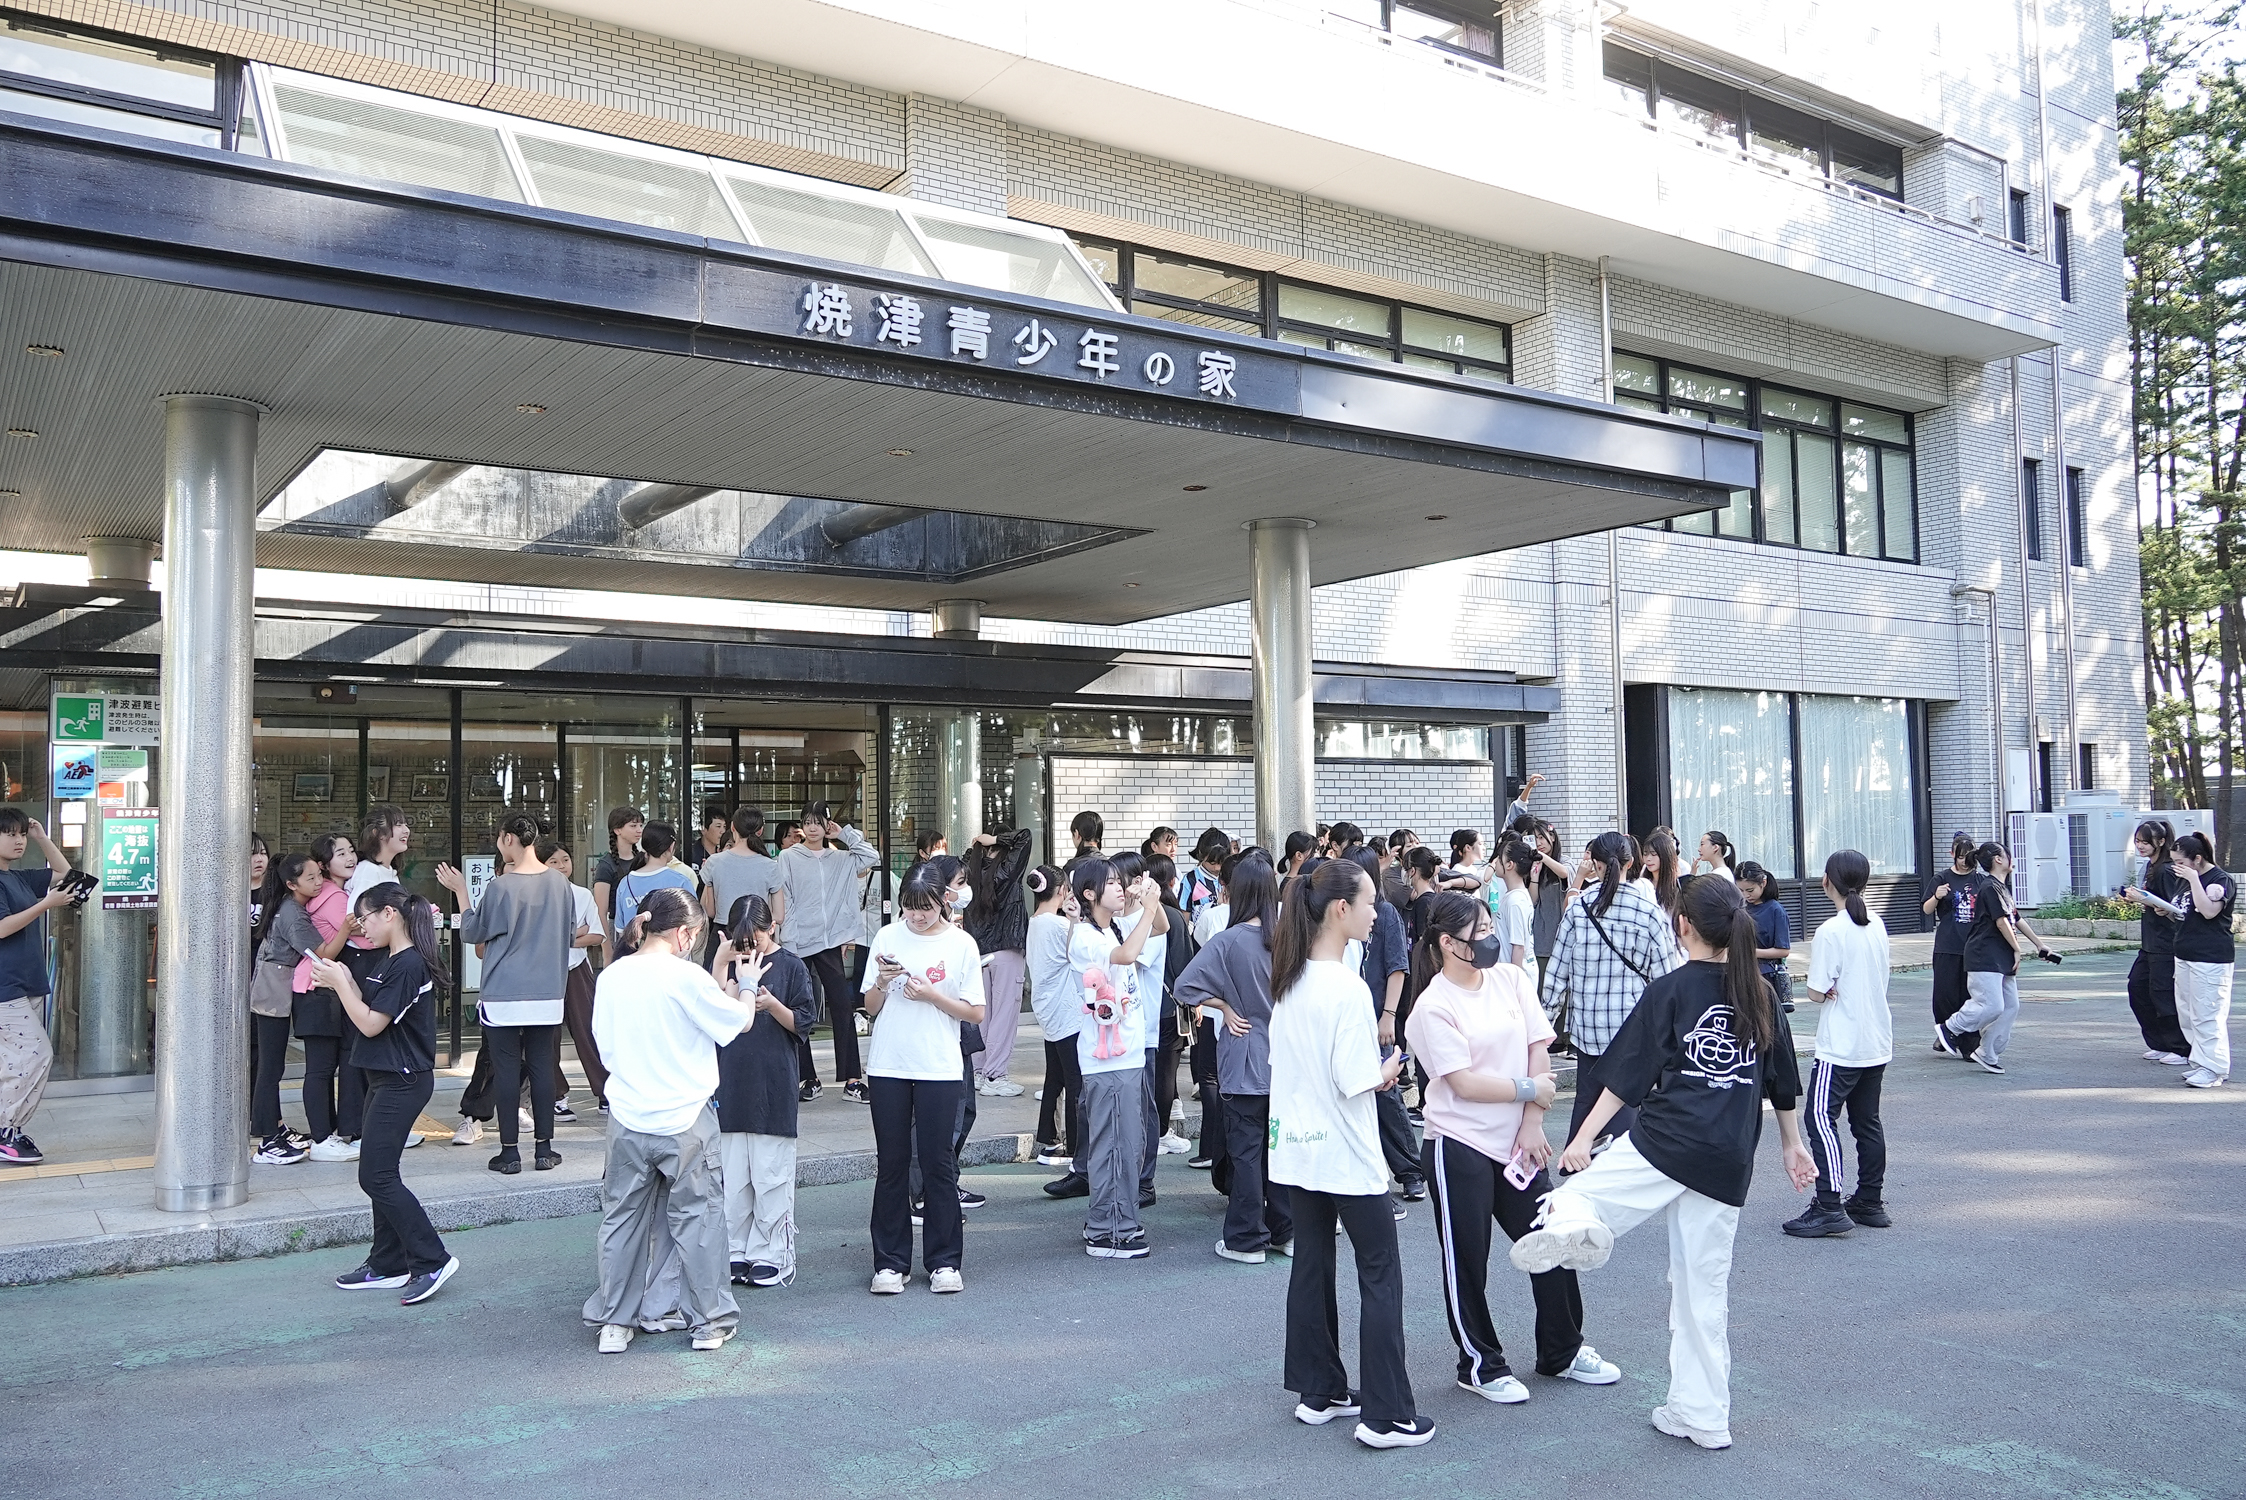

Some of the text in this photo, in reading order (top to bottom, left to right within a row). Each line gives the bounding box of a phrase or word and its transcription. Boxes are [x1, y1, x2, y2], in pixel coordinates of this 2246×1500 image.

[804, 281, 1237, 398] 焼津青少年の家
[124, 835, 149, 847] 海抜
